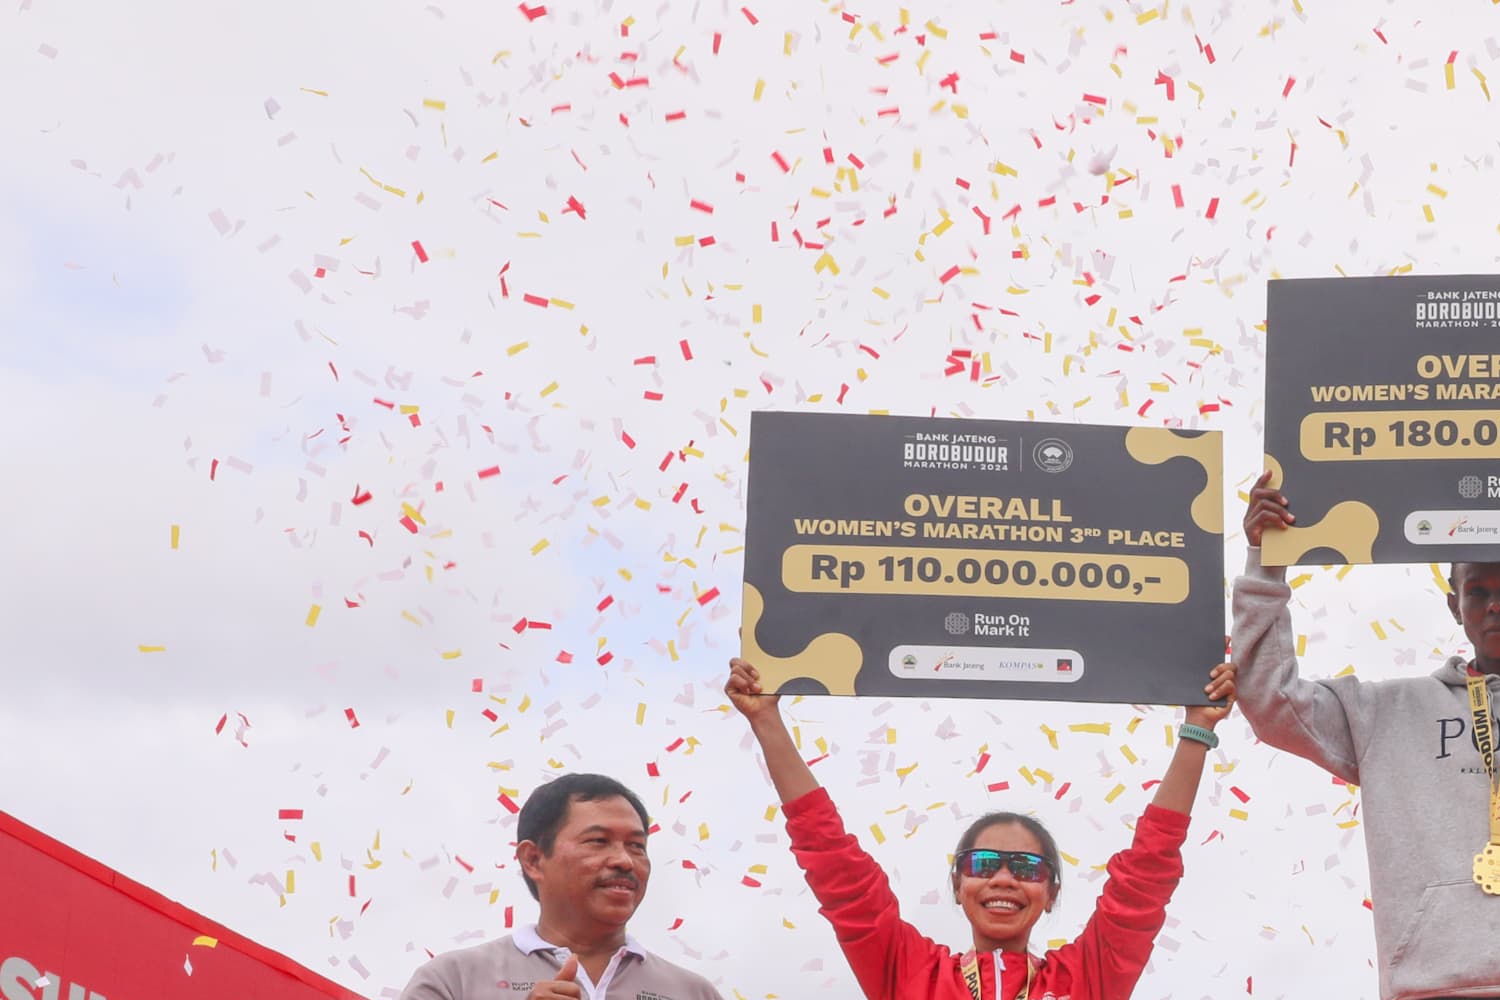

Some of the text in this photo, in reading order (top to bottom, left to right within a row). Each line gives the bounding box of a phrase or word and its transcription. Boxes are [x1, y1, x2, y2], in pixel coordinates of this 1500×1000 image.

[1428, 291, 1460, 300] BANK
[1416, 320, 1479, 328] MARATHON
[916, 433, 996, 444] BANK JATENG
[1325, 421, 1376, 456] Rp
[904, 443, 1008, 463] BOROBUDUR
[904, 461, 1008, 471] MARATHON 2024
[904, 493, 1072, 522] OVERALL
[924, 522, 1063, 543] MARATHON
[1069, 526, 1102, 544] 3RD
[1107, 529, 1185, 548] PLACE
[811, 554, 1161, 595] Rp 110.000.000,-
[974, 613, 1030, 626] Run On
[974, 625, 1030, 637] Mark It
